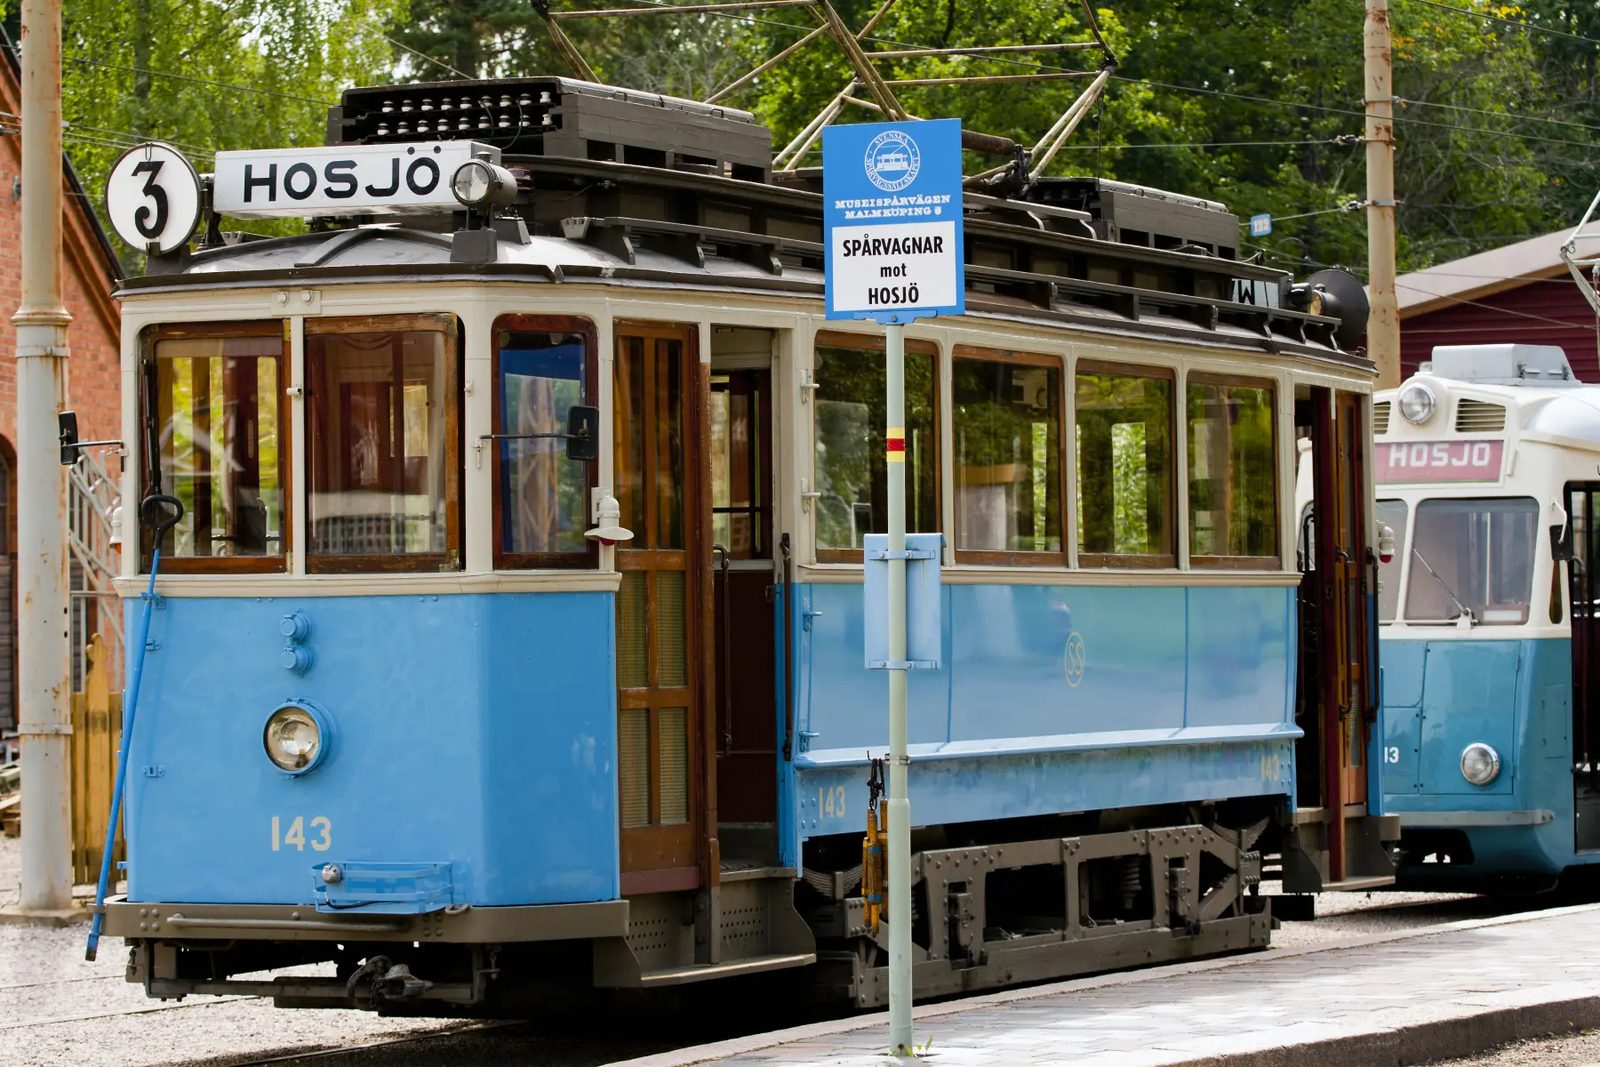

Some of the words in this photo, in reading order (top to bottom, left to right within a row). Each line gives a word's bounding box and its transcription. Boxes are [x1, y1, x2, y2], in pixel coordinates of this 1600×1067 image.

[243, 145, 441, 203] HOSJÖ
[131, 160, 169, 240] 3
[835, 194, 951, 209] MUSEISPÅRVÄGEN
[844, 206, 932, 219] MALMKÖPING
[842, 233, 943, 257] SPÅRVAGNAR
[880, 263, 907, 277] mot
[868, 282, 919, 305] HOSJÖ
[818, 785, 846, 820] 143
[271, 816, 332, 852] 143
